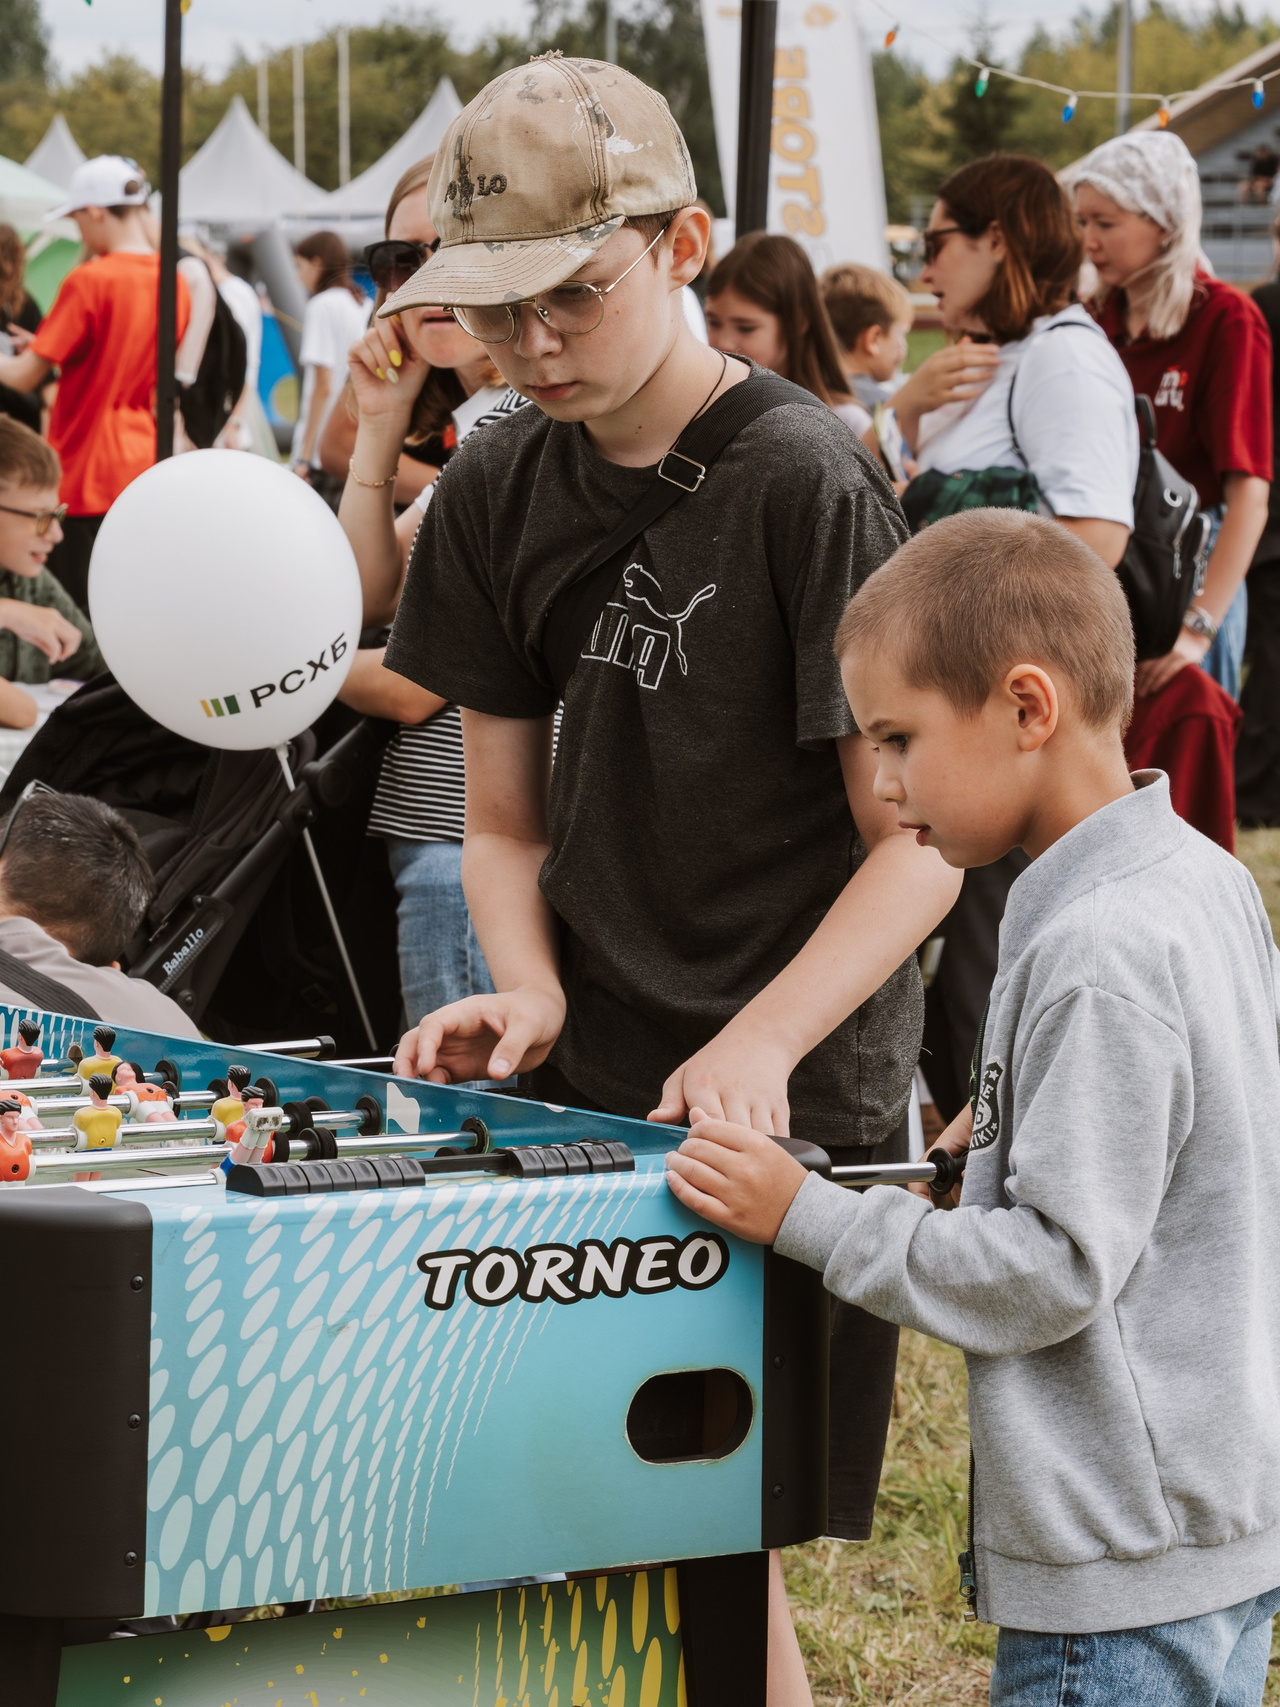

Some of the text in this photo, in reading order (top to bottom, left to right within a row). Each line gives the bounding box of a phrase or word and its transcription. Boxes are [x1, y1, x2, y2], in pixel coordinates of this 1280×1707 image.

[250, 632, 347, 709] РСХБ
[162, 928, 204, 975] Baballo
[419, 1233, 728, 1308] TORNEO
